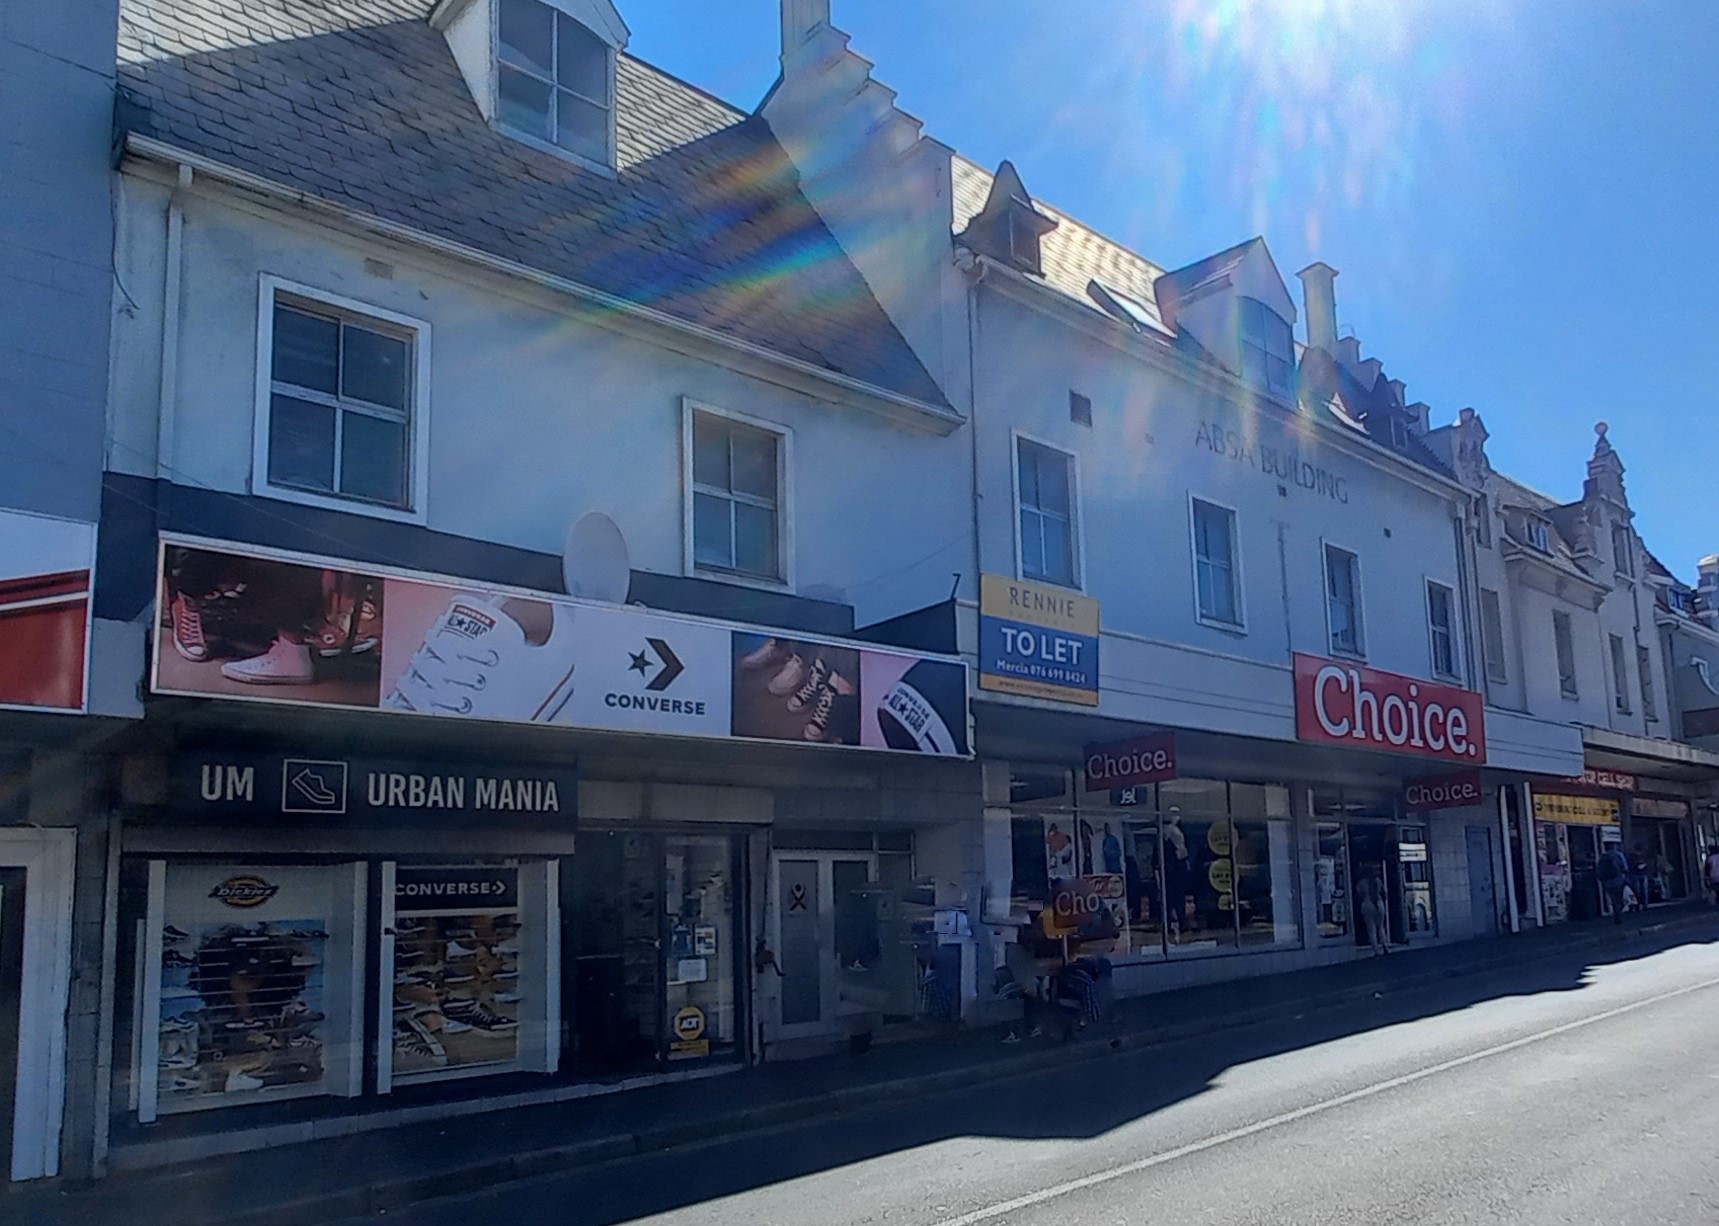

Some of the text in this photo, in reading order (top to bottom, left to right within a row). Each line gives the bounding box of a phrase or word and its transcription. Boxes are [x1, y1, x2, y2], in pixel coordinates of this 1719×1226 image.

[1195, 421, 1348, 504] ABSA BUILDING
[1008, 586, 1075, 618] RENNIE
[1000, 626, 1082, 665] TO LET
[604, 692, 706, 717] CONVERSE
[1314, 664, 1476, 757] Choice.
[1087, 748, 1174, 779] Choice.
[200, 764, 255, 802] UM
[367, 772, 560, 813] URBAN MANIA
[1405, 782, 1479, 805] Choice.
[395, 881, 491, 897] CONVERSE
[679, 1016, 700, 1030] ADT
